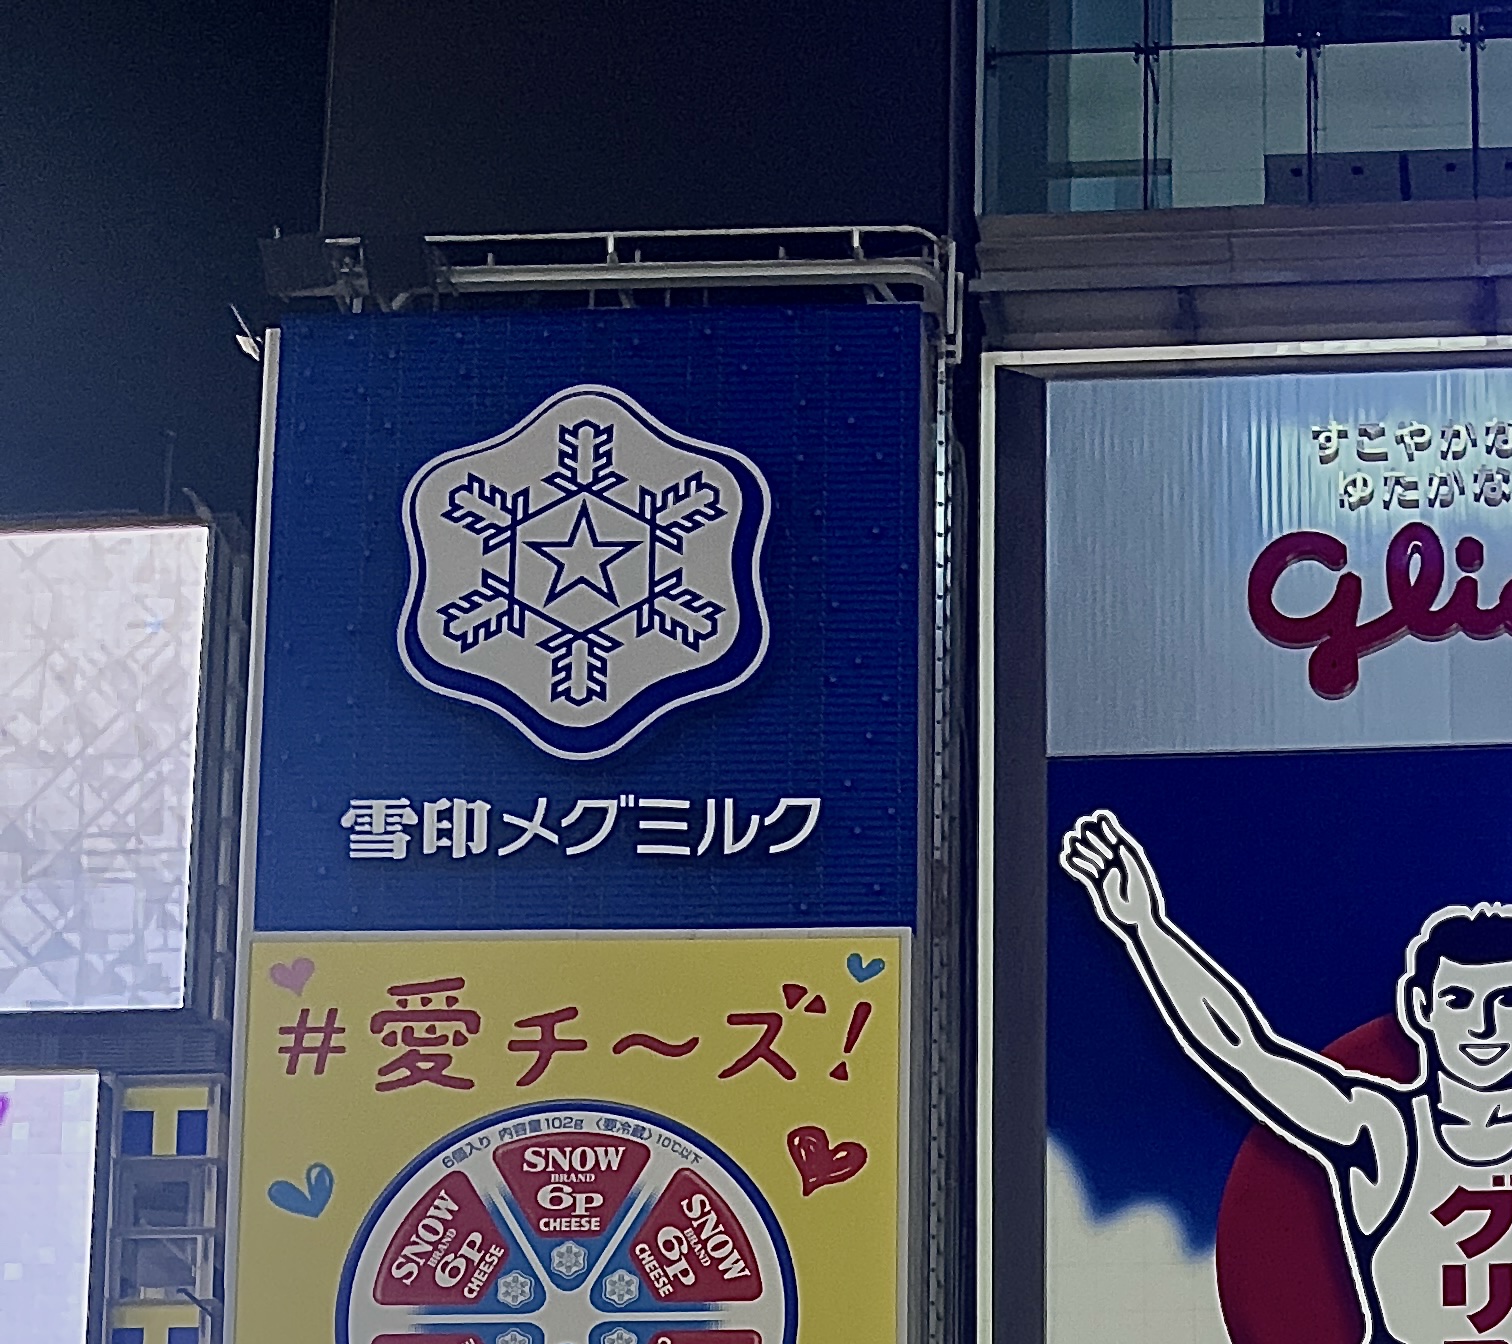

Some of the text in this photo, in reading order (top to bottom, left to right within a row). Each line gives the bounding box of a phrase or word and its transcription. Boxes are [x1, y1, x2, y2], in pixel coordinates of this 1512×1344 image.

[339, 795, 822, 860] 雪印メグミルク
[442, 1135, 492, 1169] 6個入り
[523, 1146, 626, 1172] SNOW
[551, 1173, 595, 1183] BRAND
[391, 1189, 460, 1286] SNOW
[539, 1217, 600, 1232] CHEESE
[680, 1193, 751, 1280] SNOW
[427, 1228, 457, 1268] BRAND
[684, 1228, 711, 1267] BRAND
[463, 1244, 505, 1299] CHEESE
[635, 1243, 674, 1298] CHEESE
